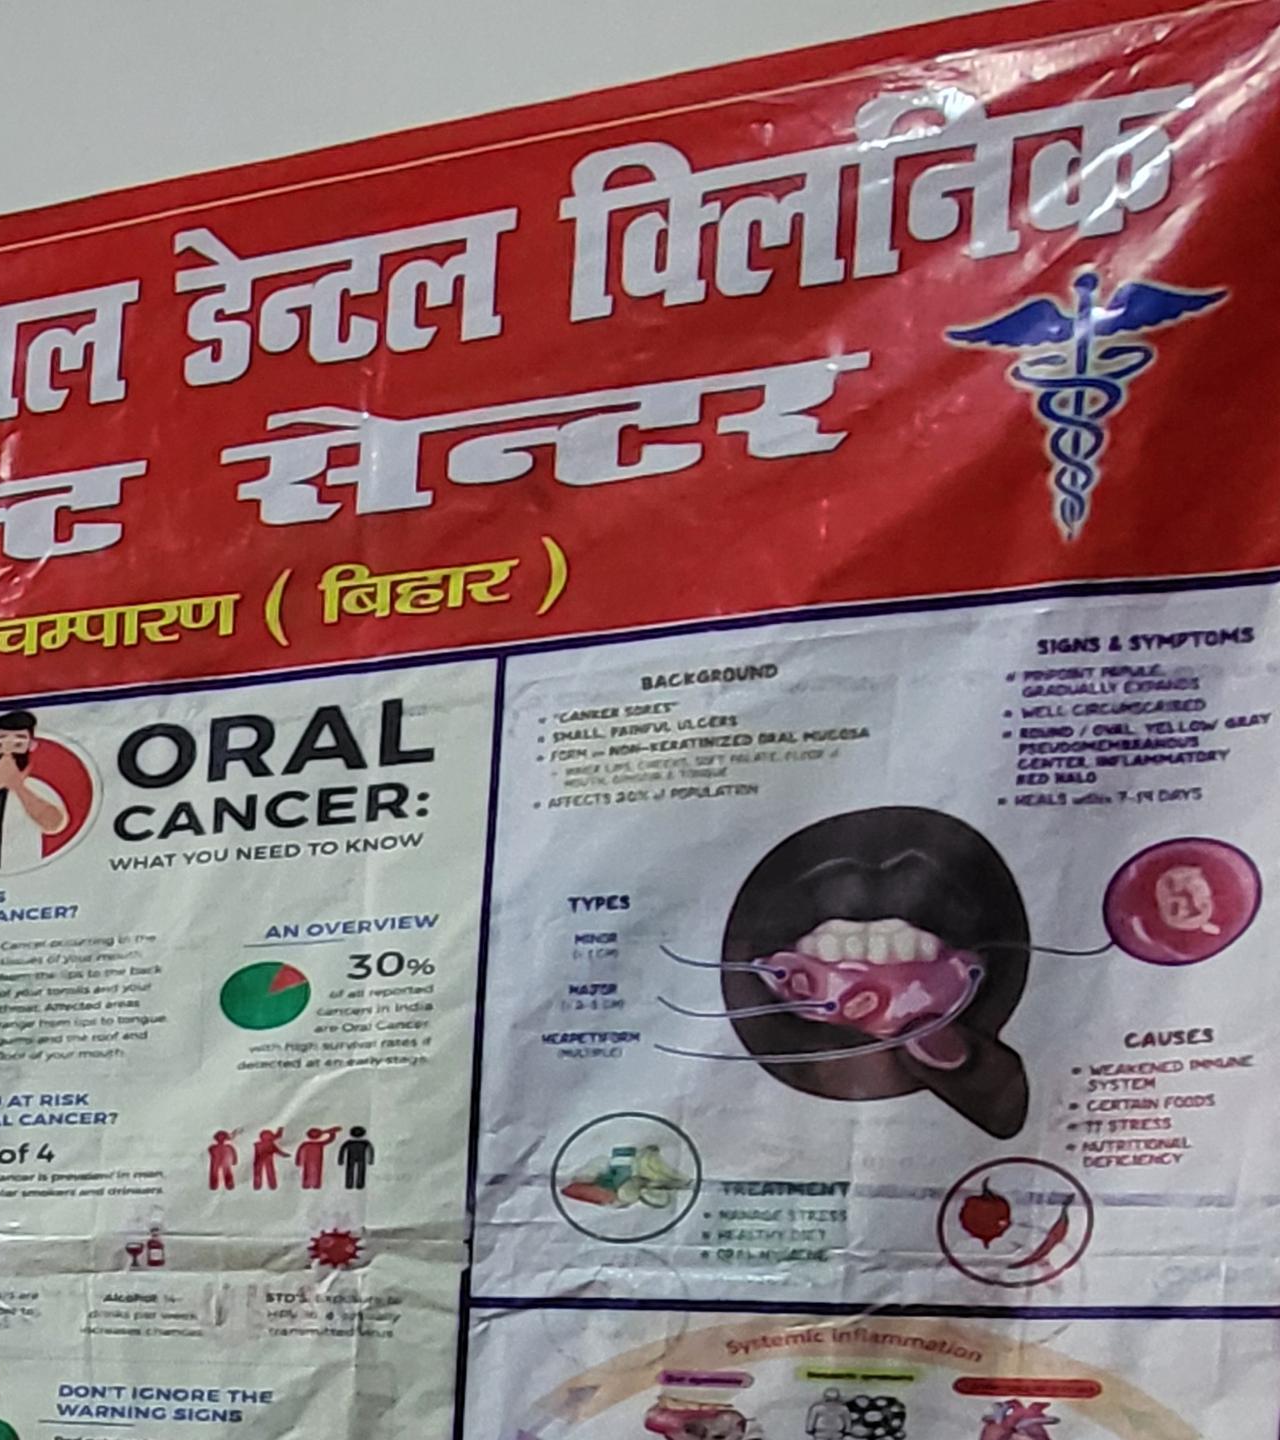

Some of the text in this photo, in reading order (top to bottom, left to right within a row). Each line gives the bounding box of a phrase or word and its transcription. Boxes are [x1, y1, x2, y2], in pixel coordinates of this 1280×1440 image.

[174, 208, 517, 386] डेन्टल
[562, 84, 1196, 321] क्लिनिक
[221, 351, 873, 527] सेन्टर
[1037, 627, 1255, 655] SIGNS & SYMPTOMS
[641, 663, 779, 691] BACKGROUND
[117, 698, 435, 789] ORAL
[113, 782, 431, 842] CANCER:
[109, 832, 425, 873] WHAT YOU NEED TO KNOW
[568, 895, 631, 912] TYPES
[265, 913, 440, 940] AN OVERVIEW
[346, 950, 436, 981] 30%
[1124, 1028, 1214, 1049] CAUSES
[7, 1093, 32, 1108] AT
[37, 1092, 89, 1107] RISK
[19, 1110, 118, 1127] CANCER?
[36, 1145, 55, 1164] 4
[725, 1327, 983, 1364] Systemic inflammation
